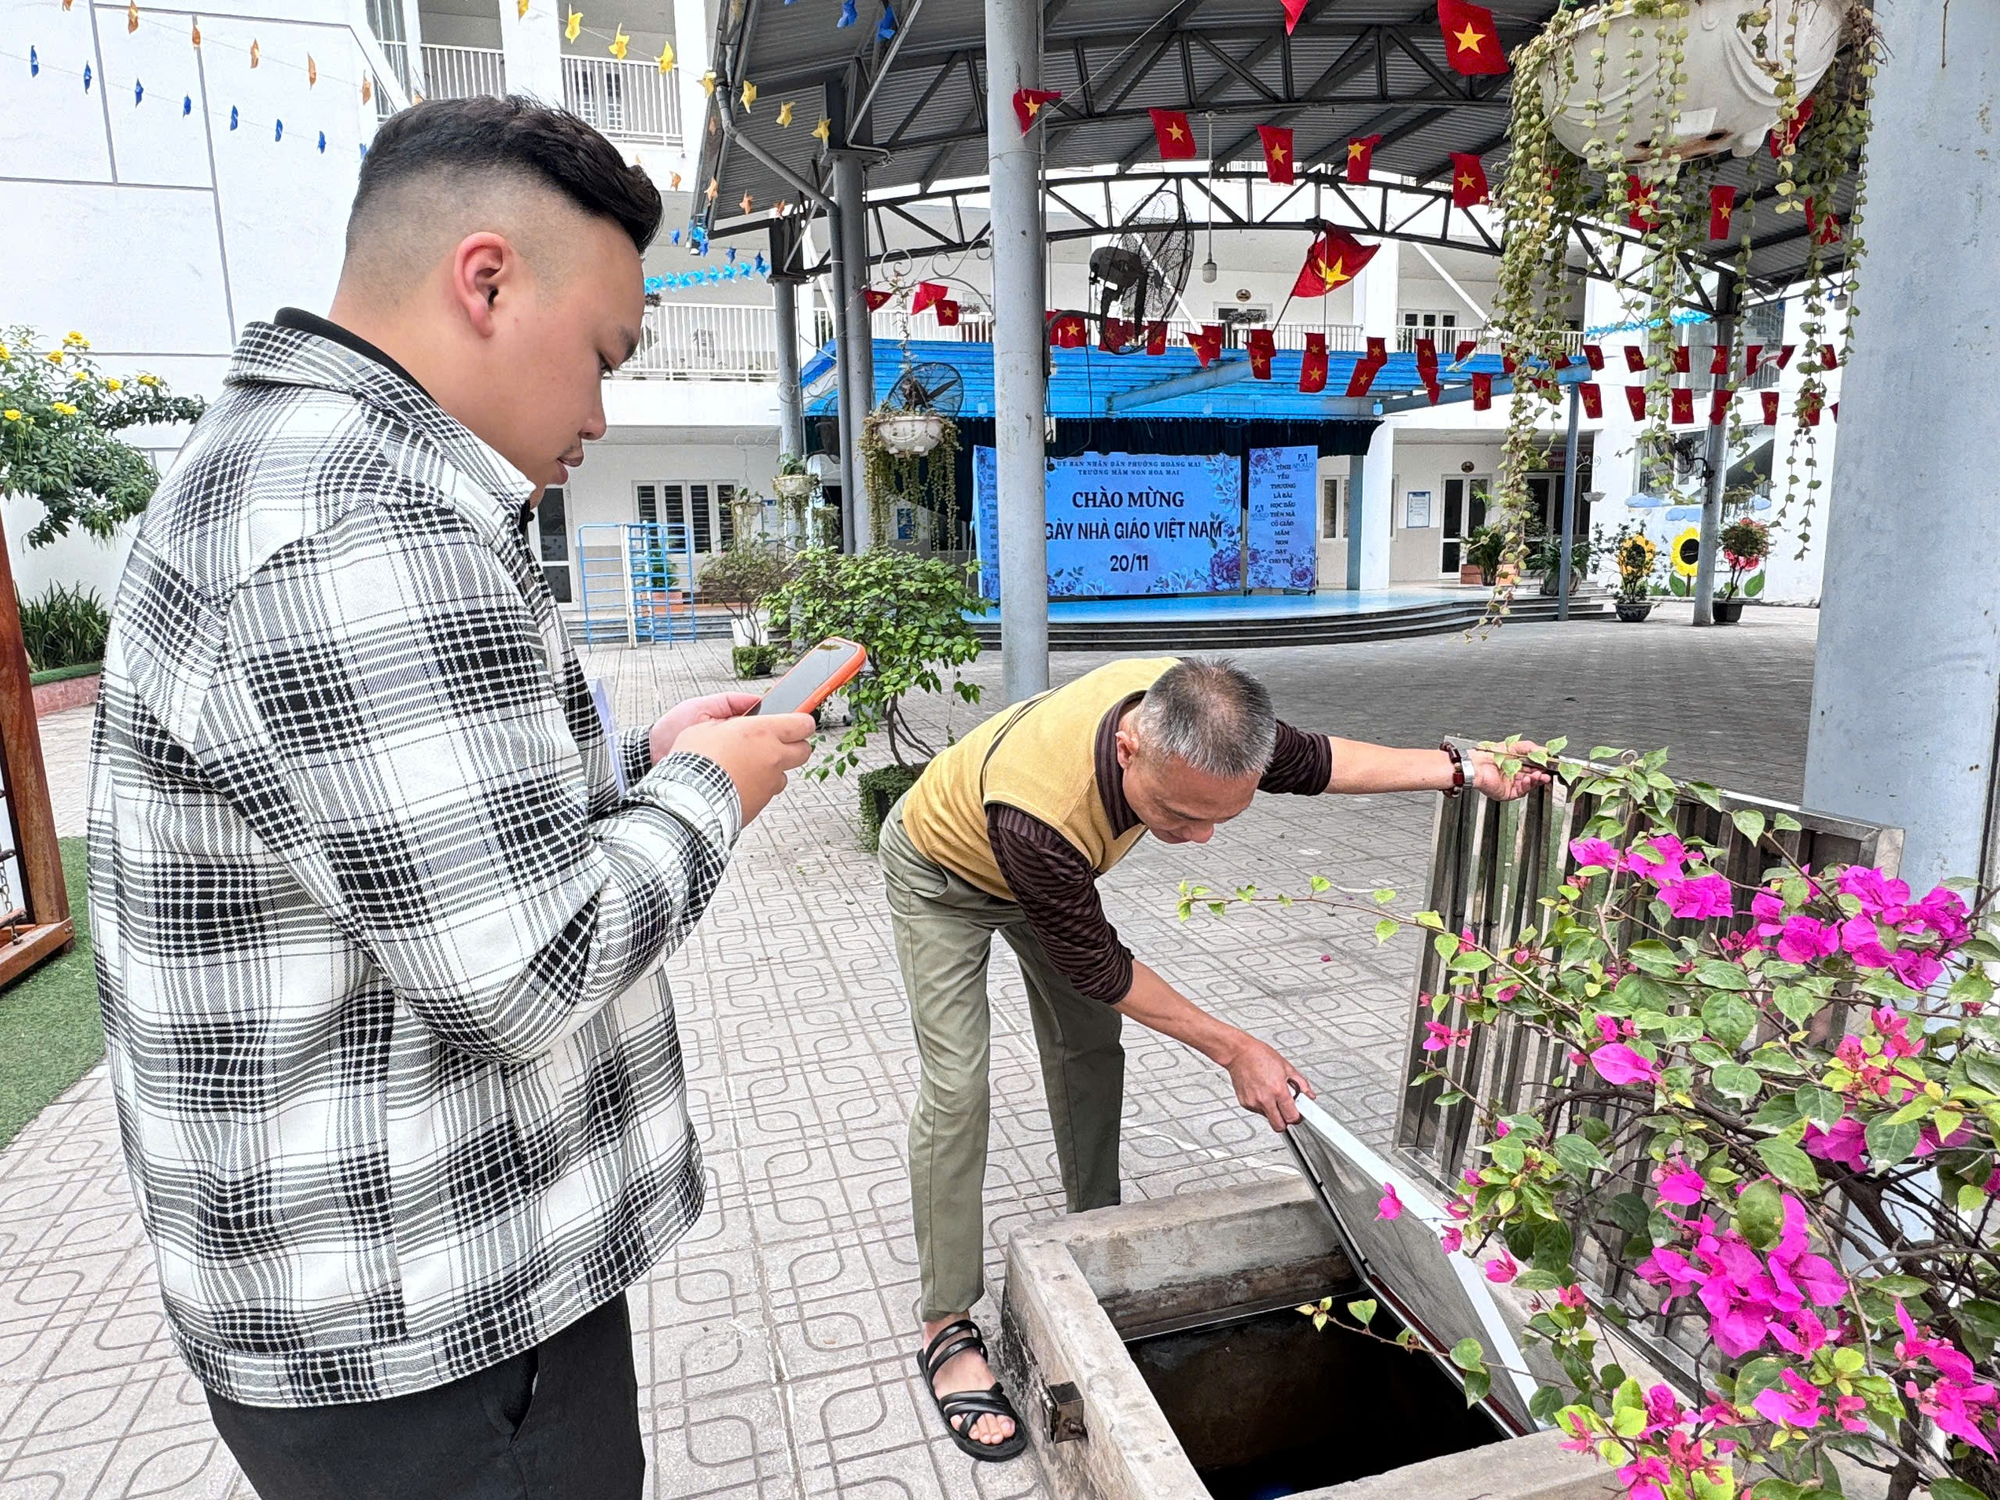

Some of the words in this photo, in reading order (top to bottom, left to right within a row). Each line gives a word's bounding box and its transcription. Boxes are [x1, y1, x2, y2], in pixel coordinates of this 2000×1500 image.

[1072, 486, 1123, 508] CHÀO
[1127, 486, 1184, 508] MỪNG
[1046, 518, 1074, 540] GÀY
[1078, 518, 1110, 540] NHÀ
[1114, 517, 1150, 539] GIÁO
[1154, 517, 1185, 542] VIỆT
[1188, 521, 1222, 538] NAM
[1110, 553, 1148, 572] 20/11
